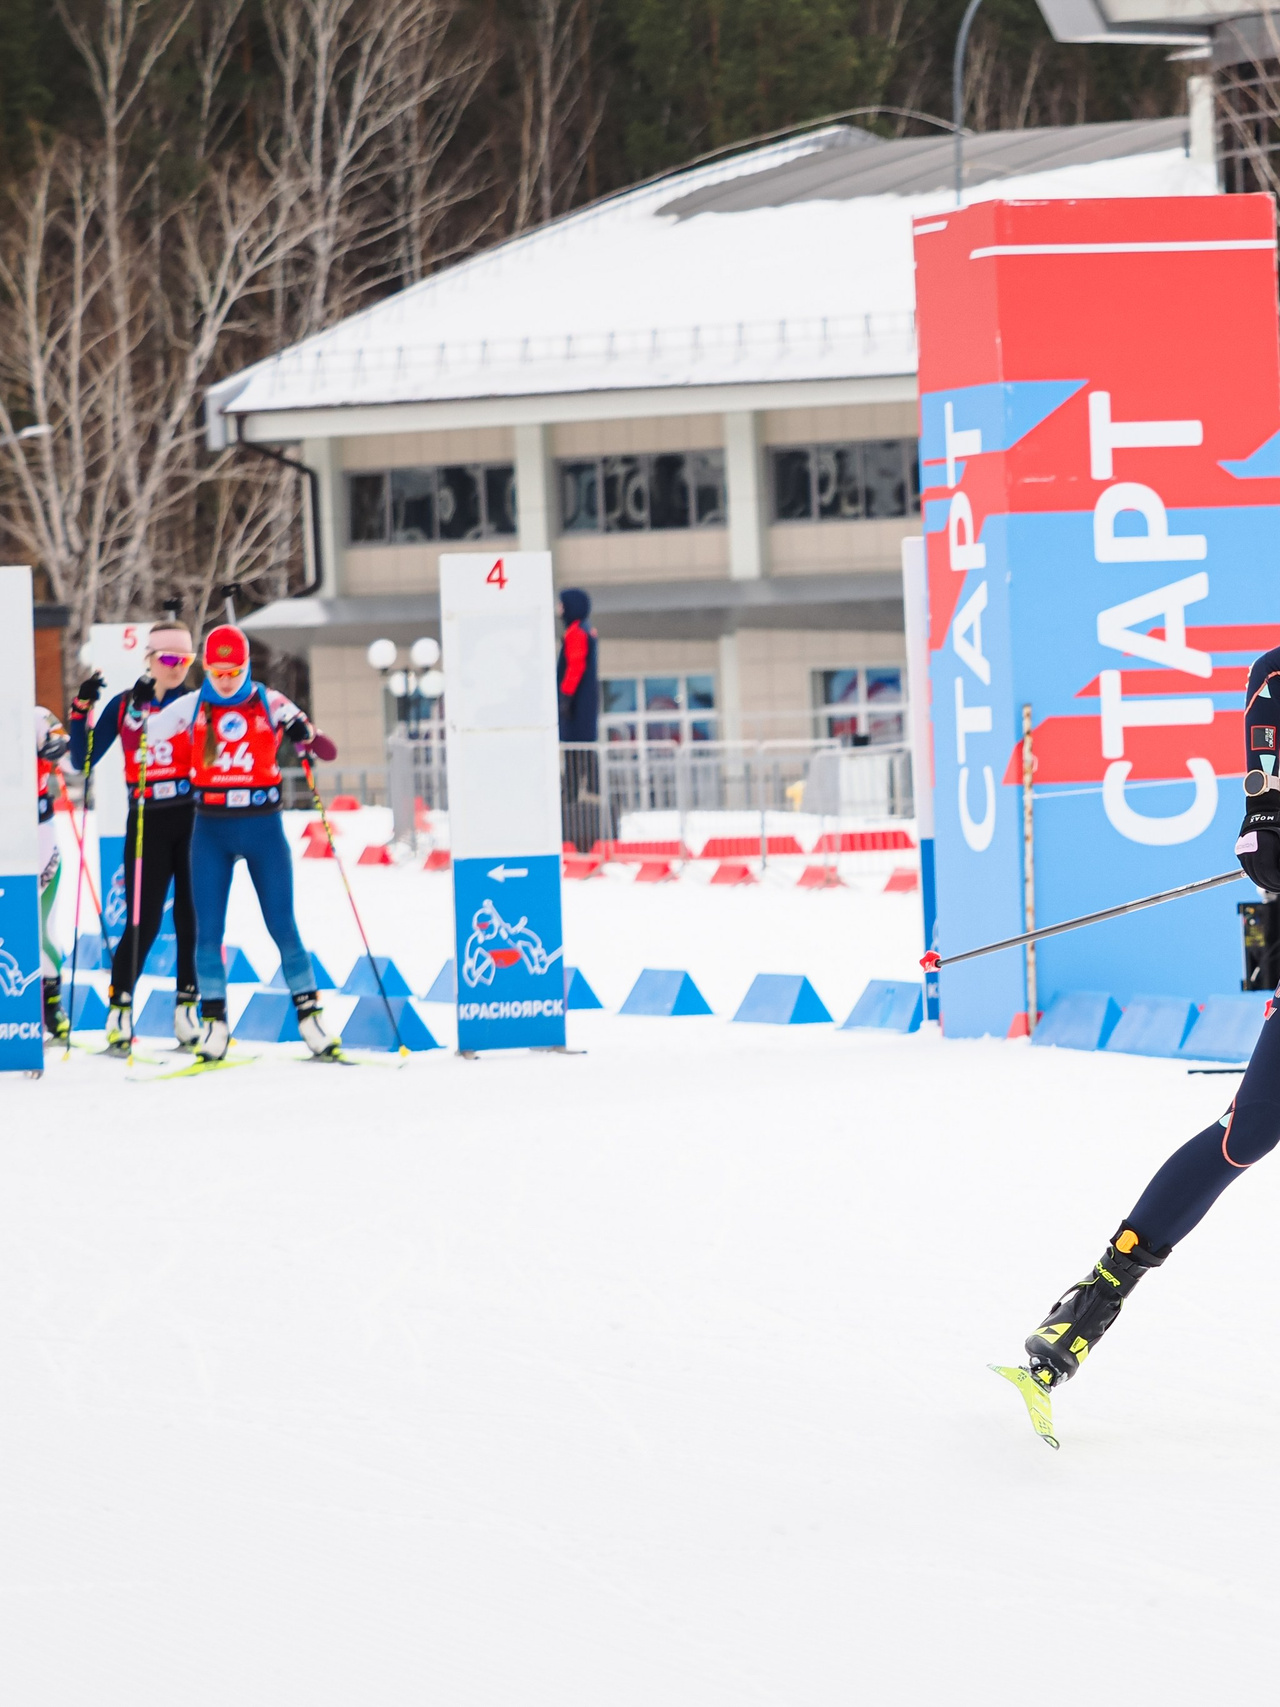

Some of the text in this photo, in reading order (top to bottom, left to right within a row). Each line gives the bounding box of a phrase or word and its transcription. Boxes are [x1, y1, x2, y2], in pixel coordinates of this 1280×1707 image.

[485, 558, 508, 590] 4
[944, 402, 996, 853] СТАРТ
[1088, 391, 1218, 847] СТАРТ
[122, 627, 138, 650] 5
[213, 741, 255, 773] 44
[459, 999, 565, 1020] КРАСНОЯРСК
[0, 1022, 41, 1040] ЯРСК
